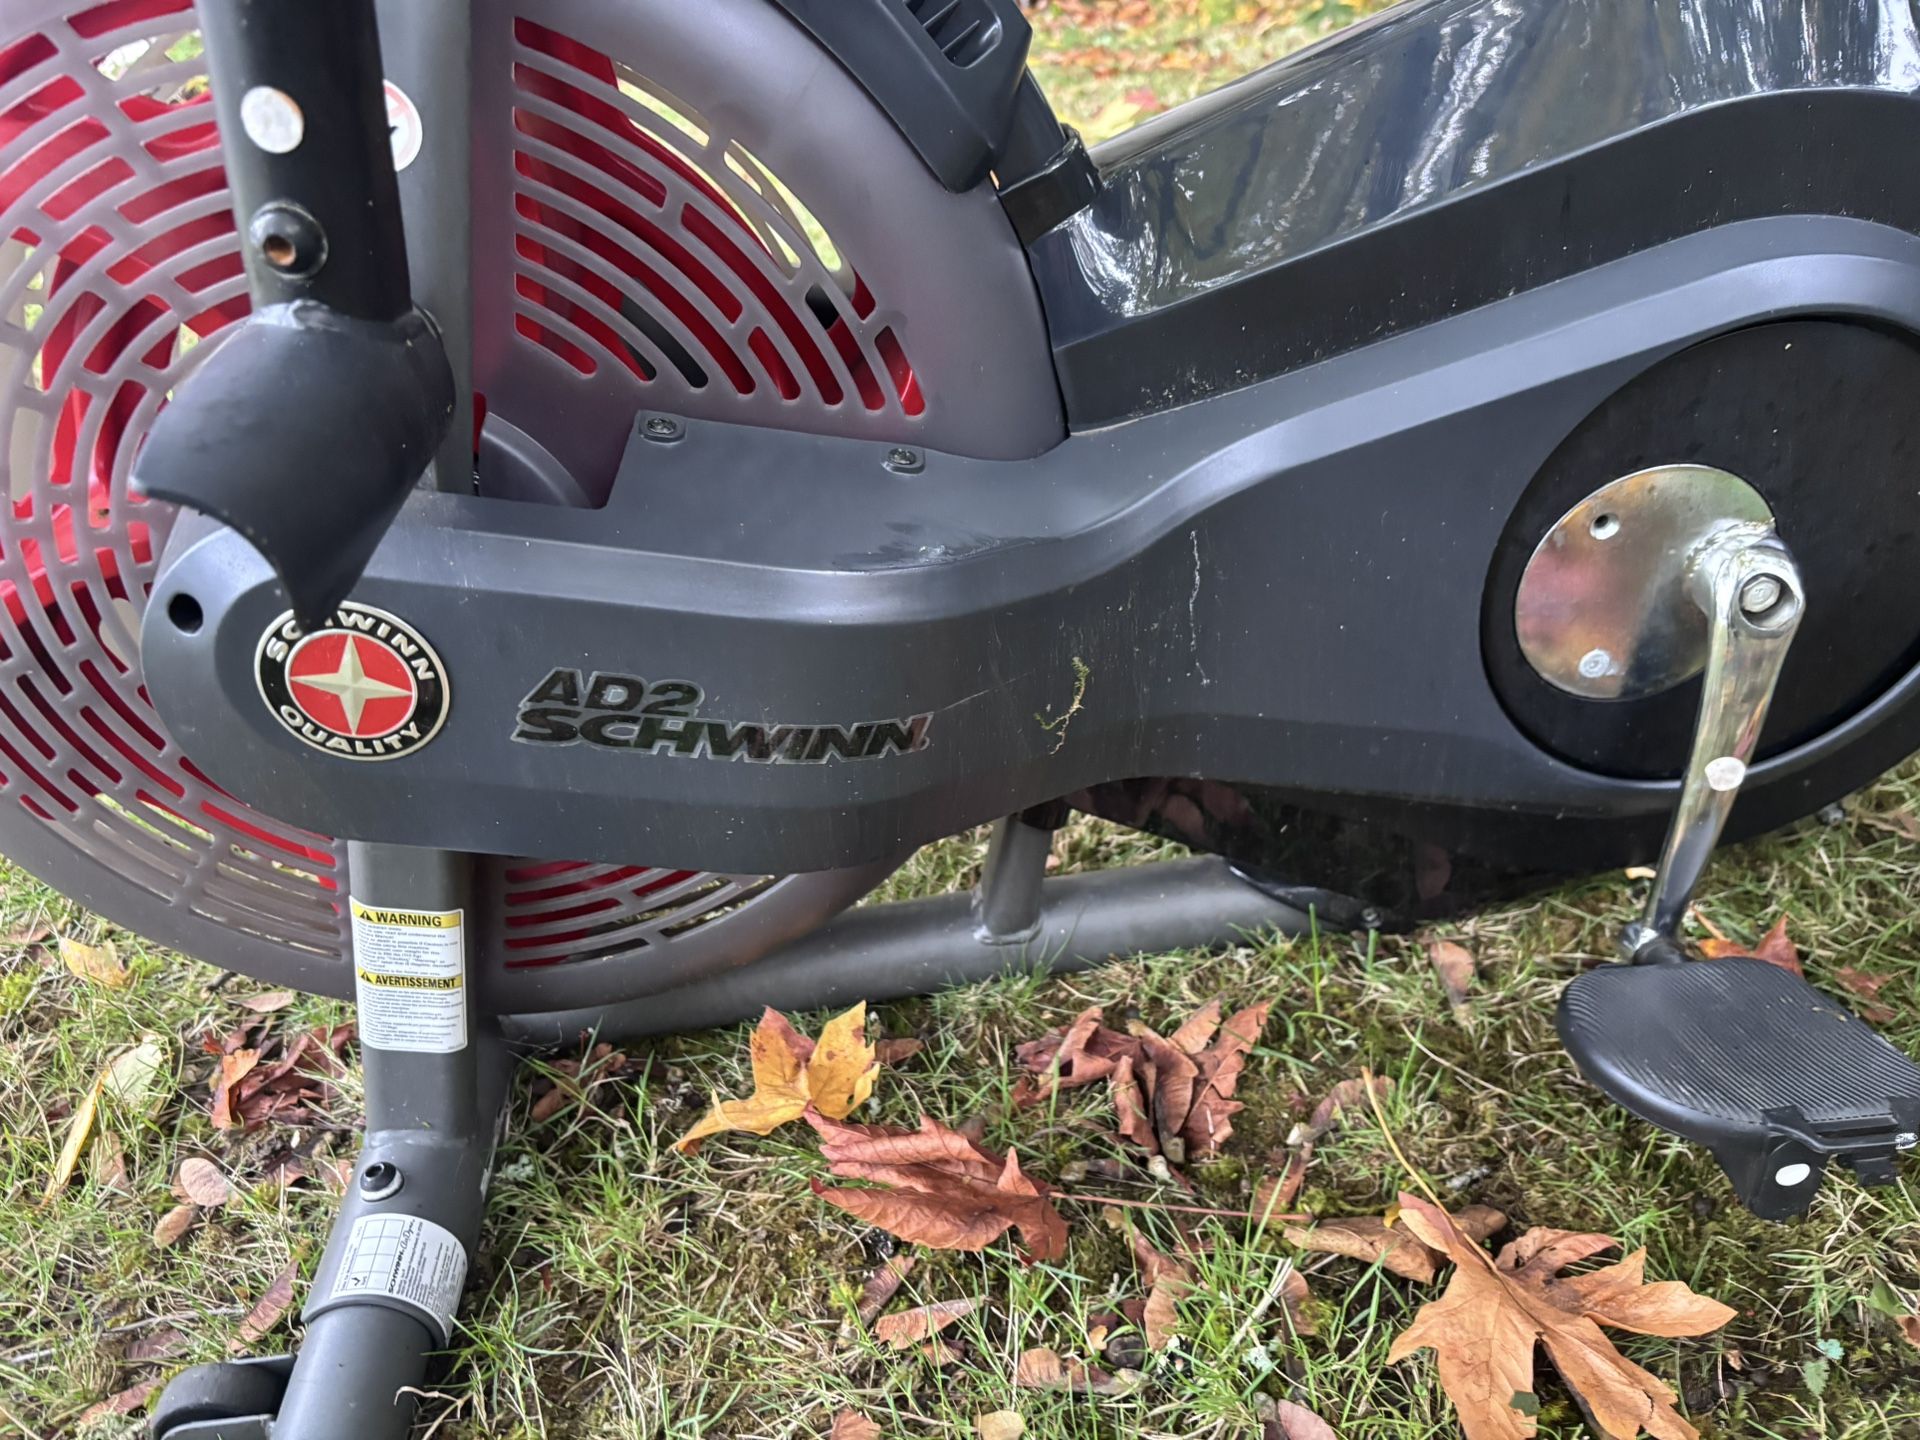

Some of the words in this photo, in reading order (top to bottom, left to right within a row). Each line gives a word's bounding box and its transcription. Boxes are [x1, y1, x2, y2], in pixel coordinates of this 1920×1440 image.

[266, 610, 435, 681] SCWINN
[519, 667, 705, 717] AD2
[280, 705, 421, 754] QUALITY
[511, 708, 934, 765] SCHWINN
[376, 912, 442, 927] WARNING
[375, 975, 457, 989] AVERTISSEMENT
